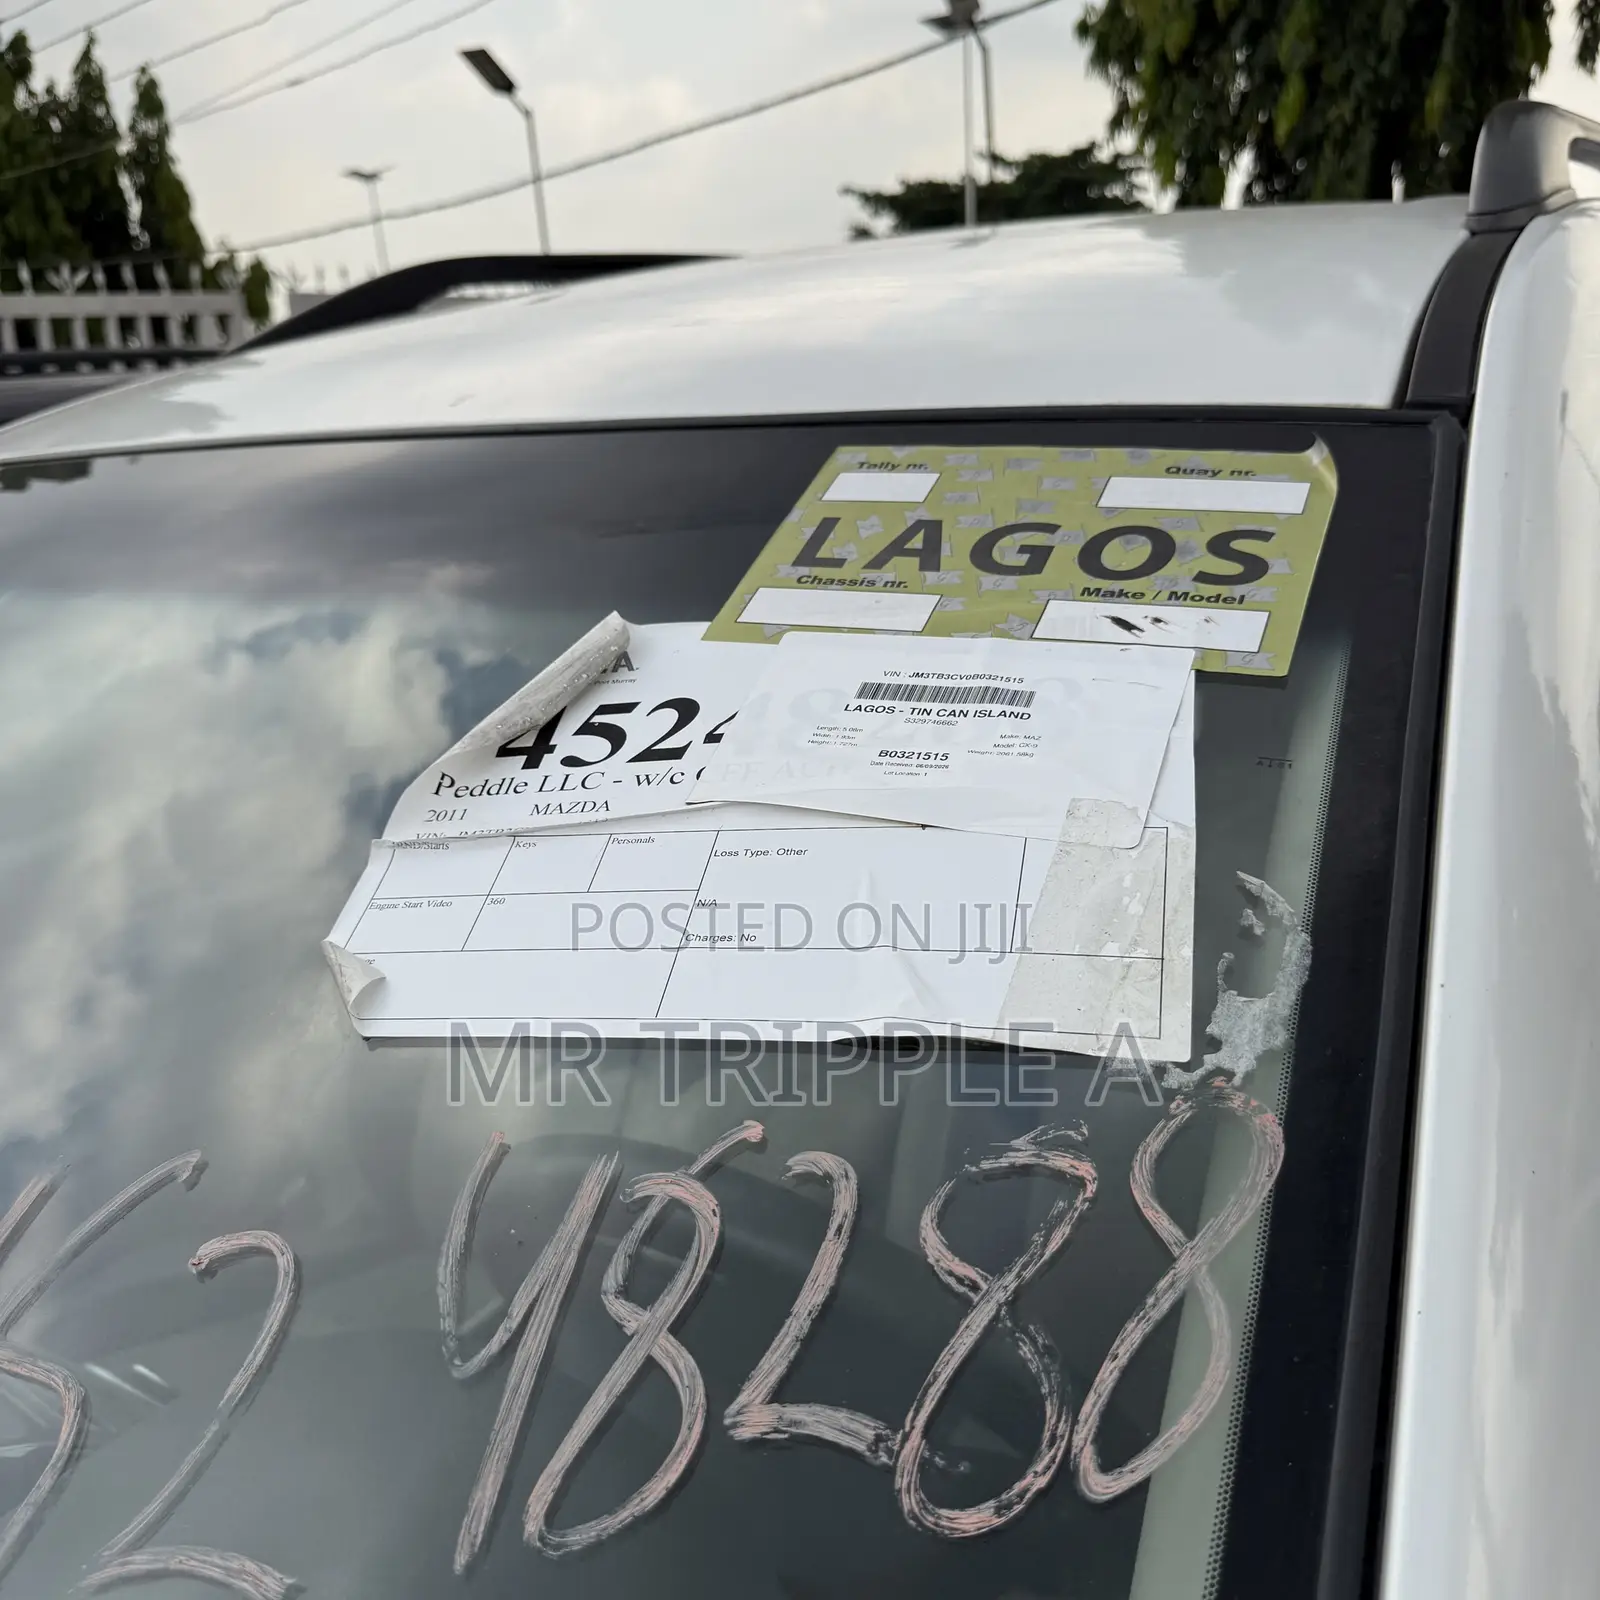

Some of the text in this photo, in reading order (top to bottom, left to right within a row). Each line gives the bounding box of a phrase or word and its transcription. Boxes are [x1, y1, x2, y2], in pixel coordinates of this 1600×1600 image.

[859, 462, 929, 472] Tally nr.
[1165, 466, 1257, 478] Quay nr.
[791, 517, 1277, 586] LAGOS
[796, 574, 909, 589] Chassis nr.
[1080, 587, 1246, 605] Make / Model
[883, 670, 901, 678] VIN
[843, 703, 897, 715] LAGOS
[910, 707, 933, 718] TIN
[936, 709, 970, 719] CAN
[972, 710, 1033, 722] ISLAND
[904, 717, 959, 727] S329746662
[878, 749, 950, 762] B0321515
[432, 771, 528, 799] Peddle
[535, 772, 606, 794] LLC
[634, 766, 686, 787] w/c
[424, 799, 612, 823] 2011 MAZDA
[514, 839, 537, 850] Keys
[611, 834, 656, 846] Personals
[713, 847, 809, 859] Loss Type: Other
[368, 899, 453, 912] Engine Start Video
[487, 897, 506, 906] 360
[696, 899, 718, 907] N/A
[685, 933, 757, 944] Charges: No
[438, 1077, 1285, 1574] 48288
